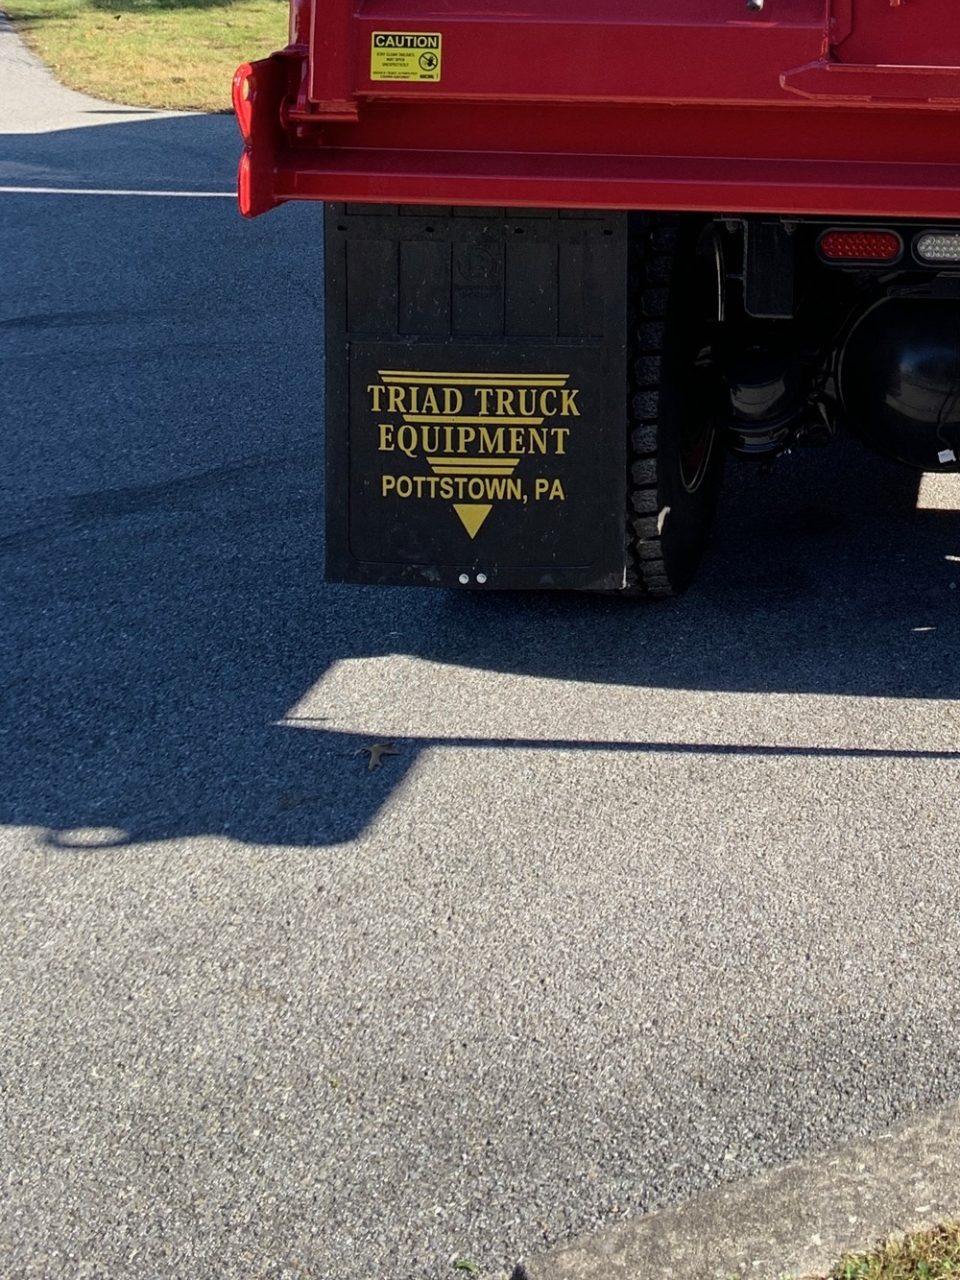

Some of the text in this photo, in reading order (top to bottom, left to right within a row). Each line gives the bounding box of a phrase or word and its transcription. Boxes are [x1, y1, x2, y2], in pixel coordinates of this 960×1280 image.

[376, 36, 437, 47] CAUTION
[367, 385, 580, 416] TRIAD TRUCK
[378, 423, 570, 458] EQUIPMENT
[382, 475, 565, 503] POTTSTOWN, PA
